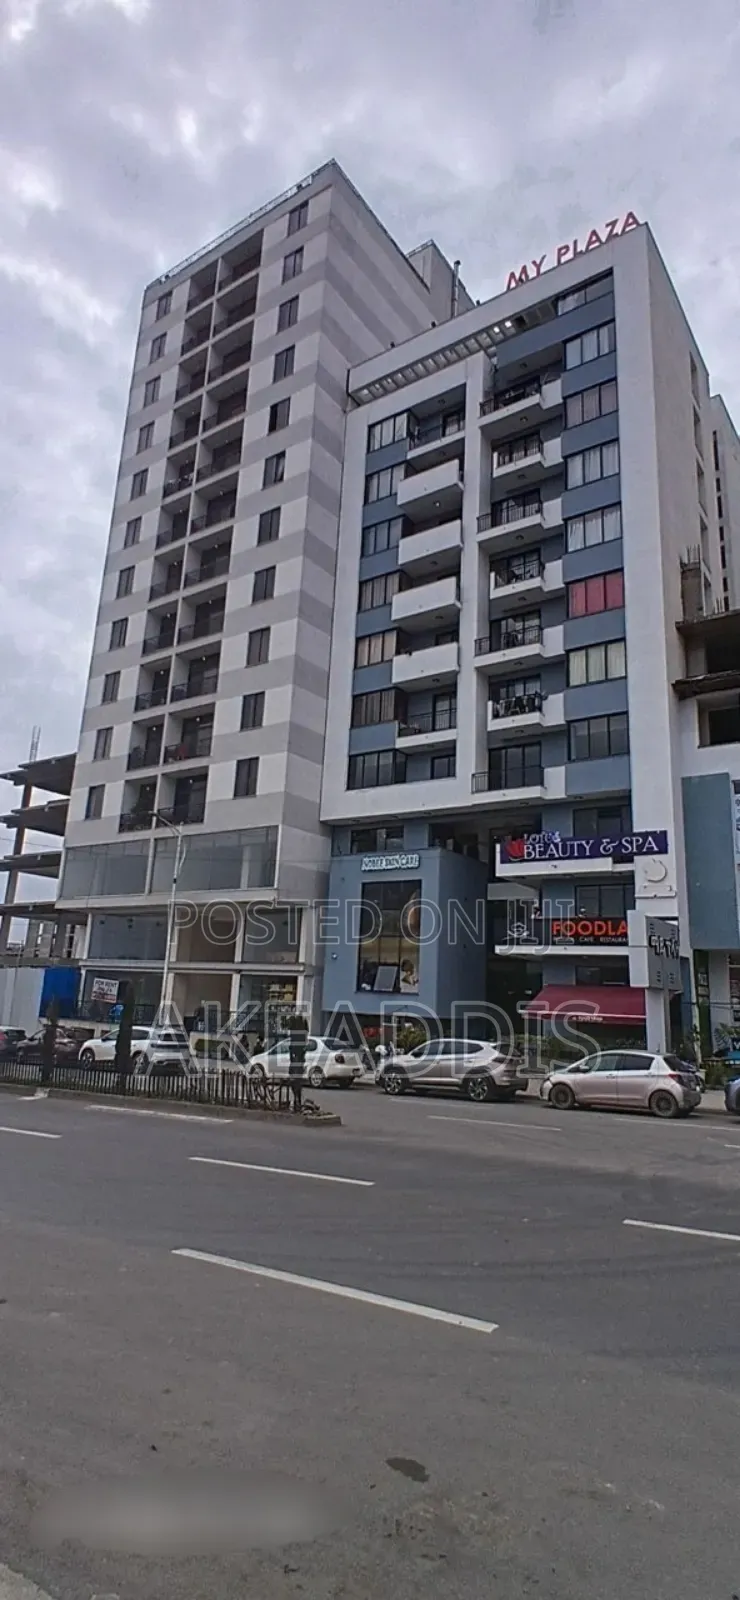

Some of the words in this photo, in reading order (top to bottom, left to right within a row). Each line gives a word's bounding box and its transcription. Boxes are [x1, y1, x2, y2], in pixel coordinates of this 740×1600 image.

[506, 254, 547, 292] MY
[556, 211, 641, 266] PLAZA
[524, 840, 594, 860] BEAUTY
[599, 838, 619, 854] &
[621, 836, 660, 854] SPA
[552, 920, 627, 936] FOODLA
